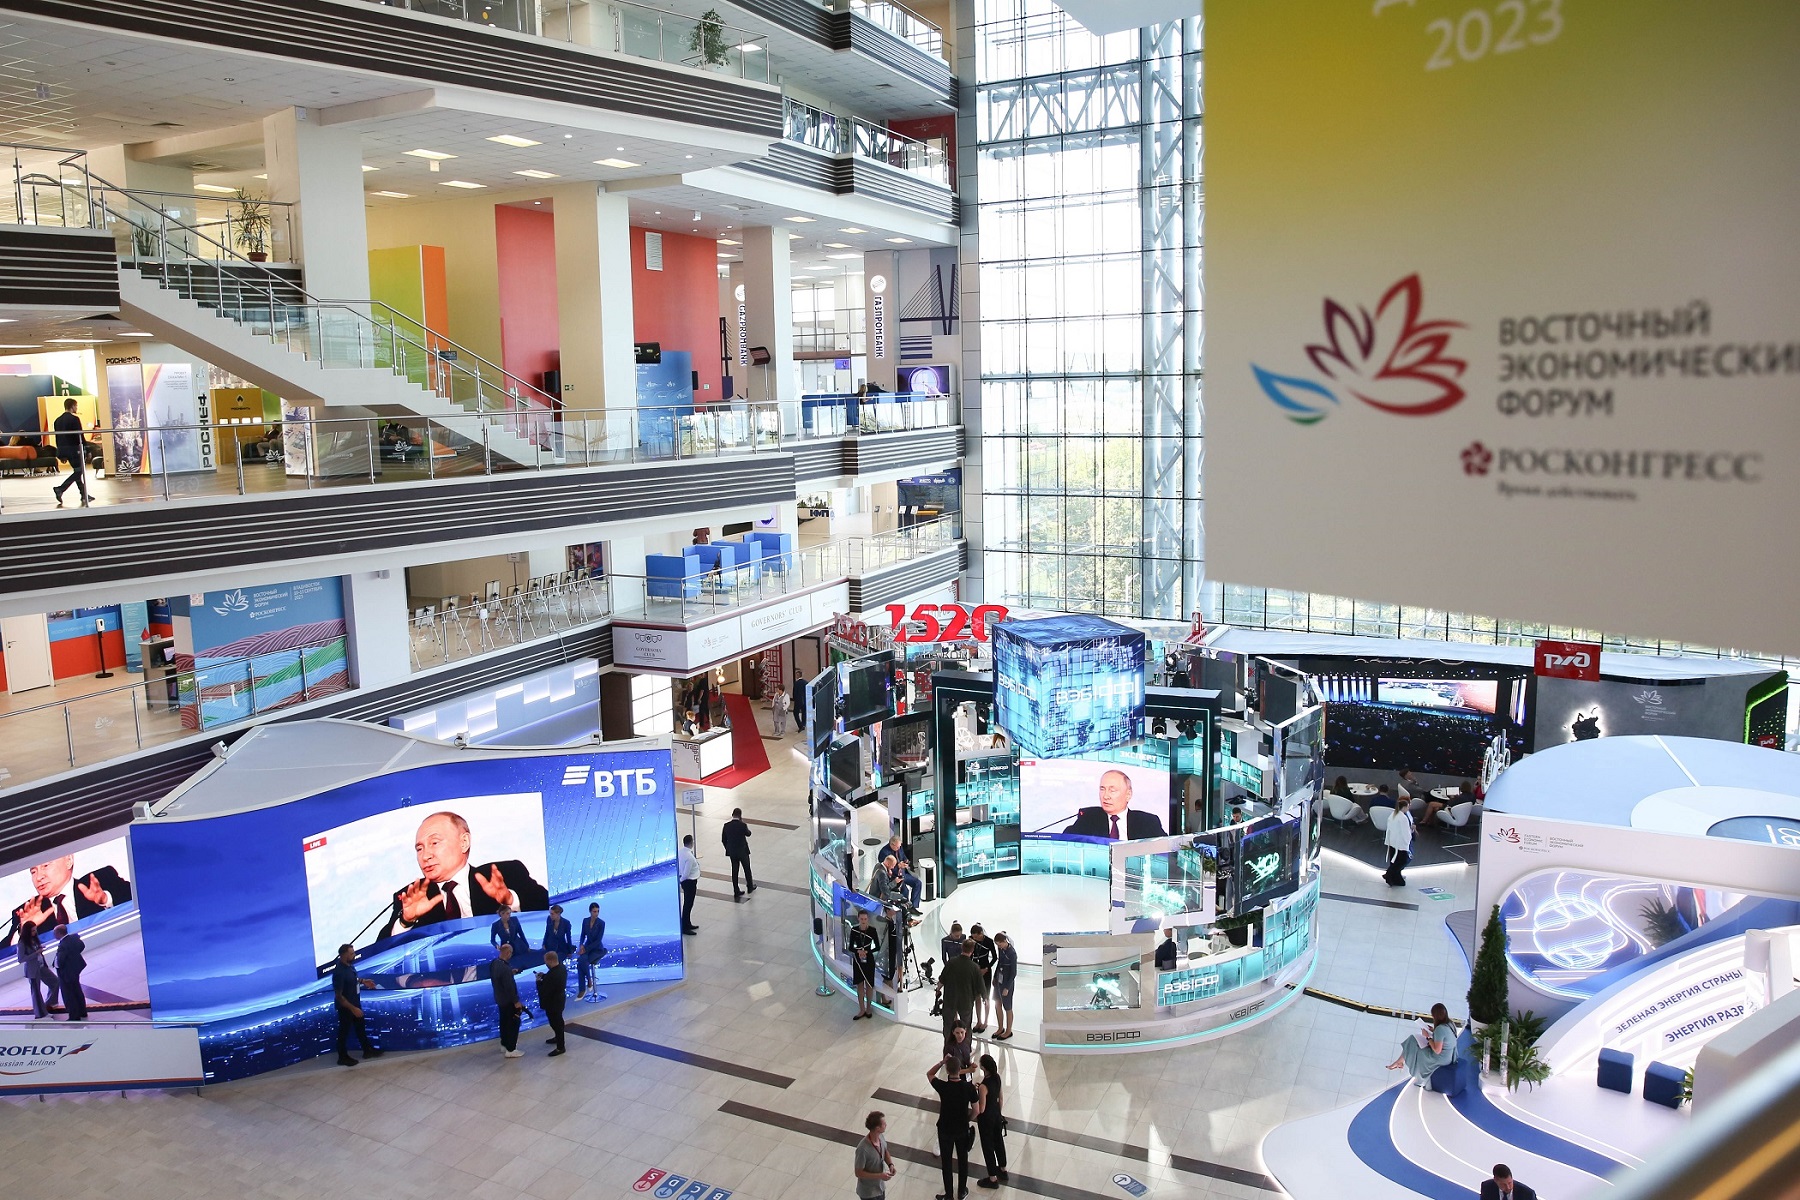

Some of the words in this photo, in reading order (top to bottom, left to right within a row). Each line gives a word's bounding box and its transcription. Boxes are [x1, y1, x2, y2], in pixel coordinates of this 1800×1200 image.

[1425, 0, 1563, 71] 2023
[874, 296, 884, 358] ГАЗПРОМБАНК
[1498, 299, 1710, 346] ВОСТОЧНЫЙ
[1498, 342, 1800, 382] ЭКОНОМИЧЕСКИ
[1496, 387, 1613, 417] ФОРУМ
[1499, 448, 1764, 483] РОСКОНГРЕСС
[789, 605, 803, 616] CLUB
[885, 603, 1009, 643] 1520
[1120, 750, 1157, 762] ЭКСПЕРТ
[594, 768, 657, 798] ВТБ
[310, 840, 321, 849] LIVE
[1615, 1006, 1659, 1034] ЗЕЛЕНАЯ
[1657, 985, 1701, 1010] ЭНЕРГИЯ
[1701, 969, 1743, 990] СТРАНЫ
[1665, 1015, 1717, 1043] ЭНЕРГИЯ
